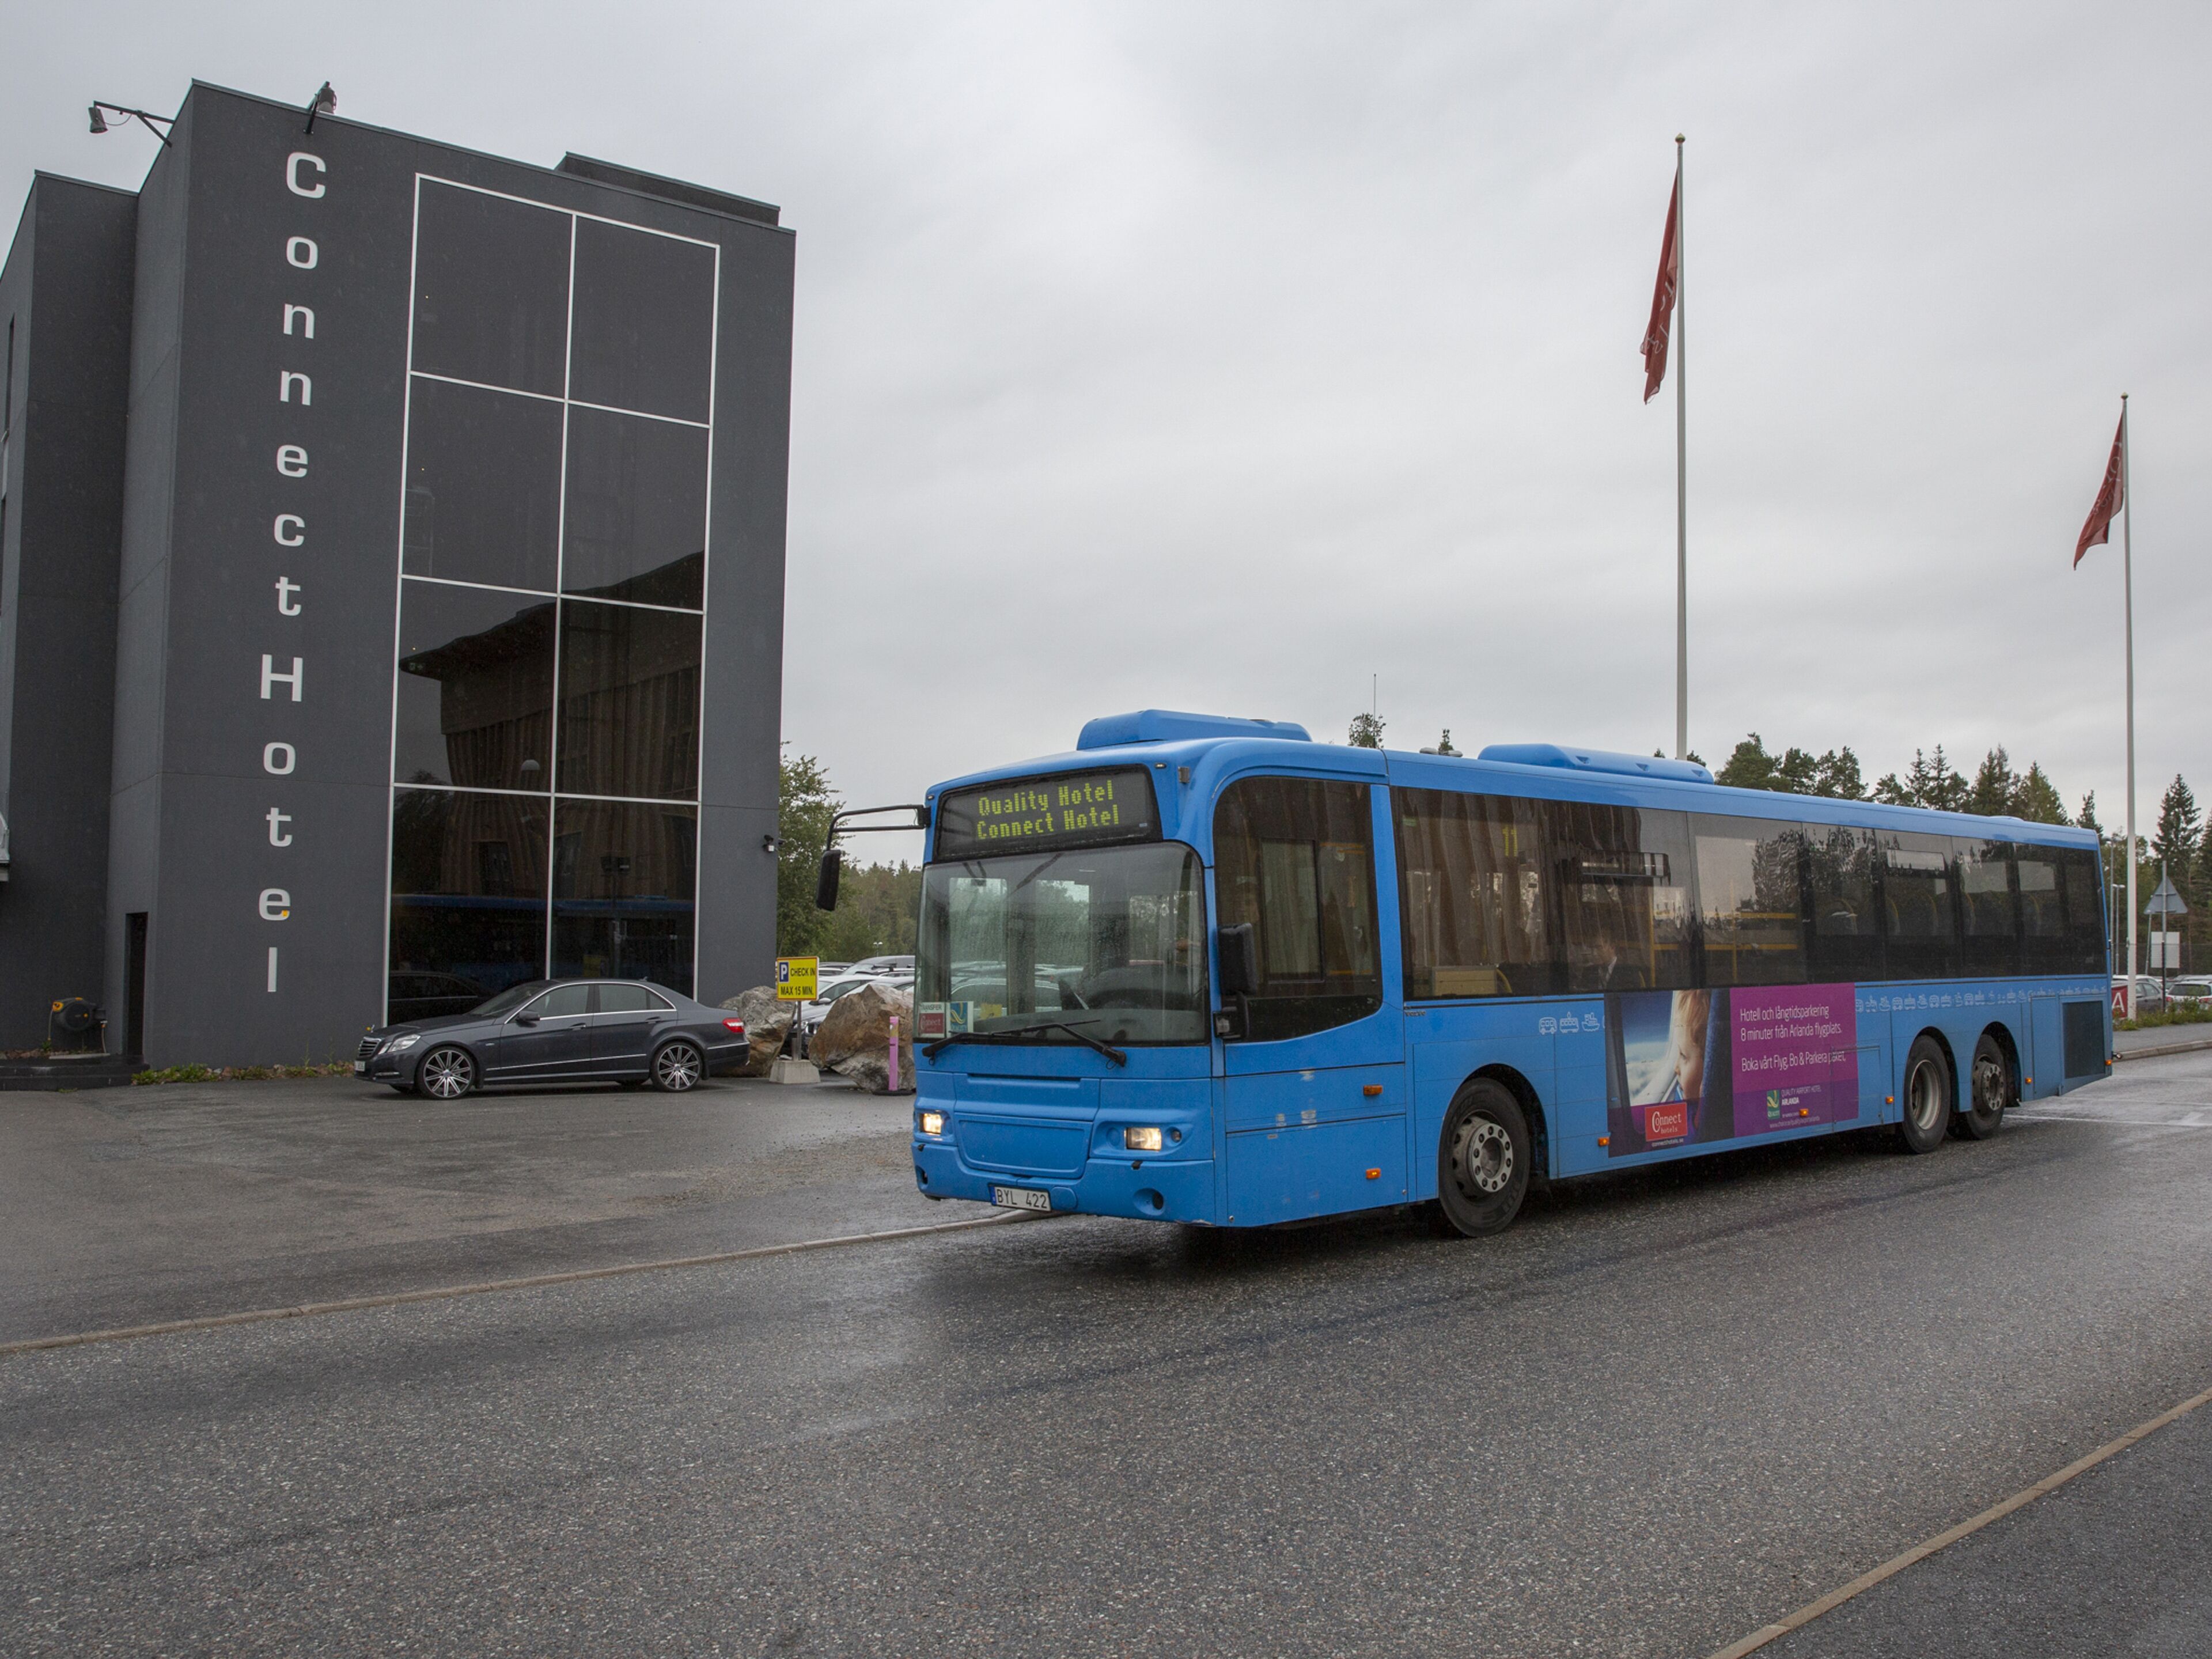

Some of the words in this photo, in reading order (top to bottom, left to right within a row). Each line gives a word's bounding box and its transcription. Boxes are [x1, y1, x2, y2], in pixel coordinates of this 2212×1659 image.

[979, 790, 1048, 816] Quality
[1058, 779, 1113, 806] Hotel
[977, 812, 1054, 839] Connect
[1063, 804, 1119, 830] Hotel
[781, 964, 788, 980] P
[790, 968, 809, 976] CHECK
[810, 968, 816, 976] IN
[781, 986, 793, 995] MAX
[794, 986, 801, 995] 15
[802, 986, 814, 995] MIN.
[1740, 1007, 1760, 1021] Hotell
[1762, 1008, 1774, 1020] och
[1775, 1004, 1830, 1022] långtidsparkering
[1741, 1028, 1746, 1041] 8
[1747, 1027, 1773, 1041] minuter
[1775, 1024, 1788, 1039] från
[1790, 1024, 1813, 1037] Arlanda
[1742, 1058, 1758, 1072] Boka
[1760, 1055, 1773, 1070] vårt
[1789, 1054, 1798, 1066] Bo
[1799, 1052, 1805, 1066] &
[1805, 1051, 1827, 1065] Parkera
[1782, 1097, 1800, 1105] ARLANDA
[1652, 1111, 1681, 1132] Connect
[1661, 1125, 1677, 1134] hotels
[997, 1189, 1017, 1205] BYL
[1026, 1192, 1047, 1209] 422
